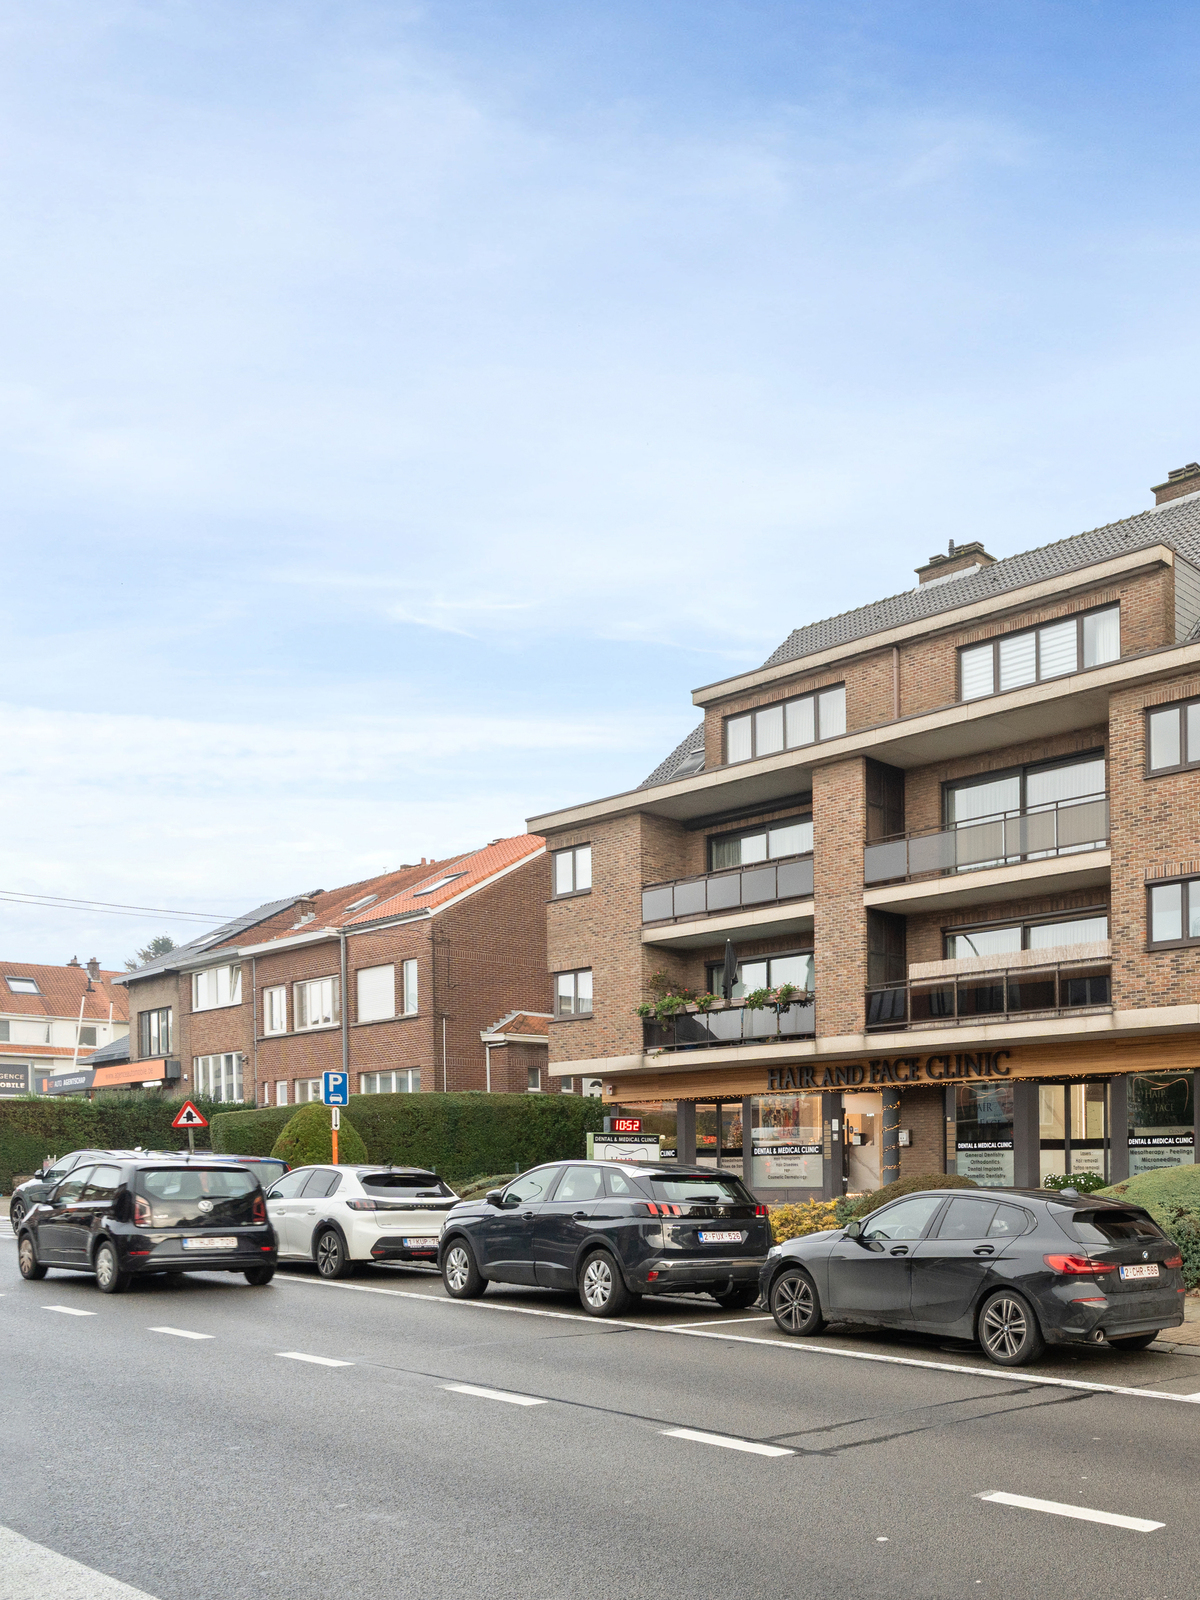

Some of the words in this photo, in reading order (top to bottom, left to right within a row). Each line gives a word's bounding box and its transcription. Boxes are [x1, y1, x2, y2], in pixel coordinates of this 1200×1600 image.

[767, 1065, 818, 1090] HAIR
[821, 1065, 864, 1087] AND
[869, 1056, 920, 1083] FACE
[926, 1050, 1010, 1080] CLINIC
[63, 1076, 87, 1087] AGENTSCHAP
[615, 1120, 640, 1131] 10:52
[778, 1146, 801, 1154] MEDICAL
